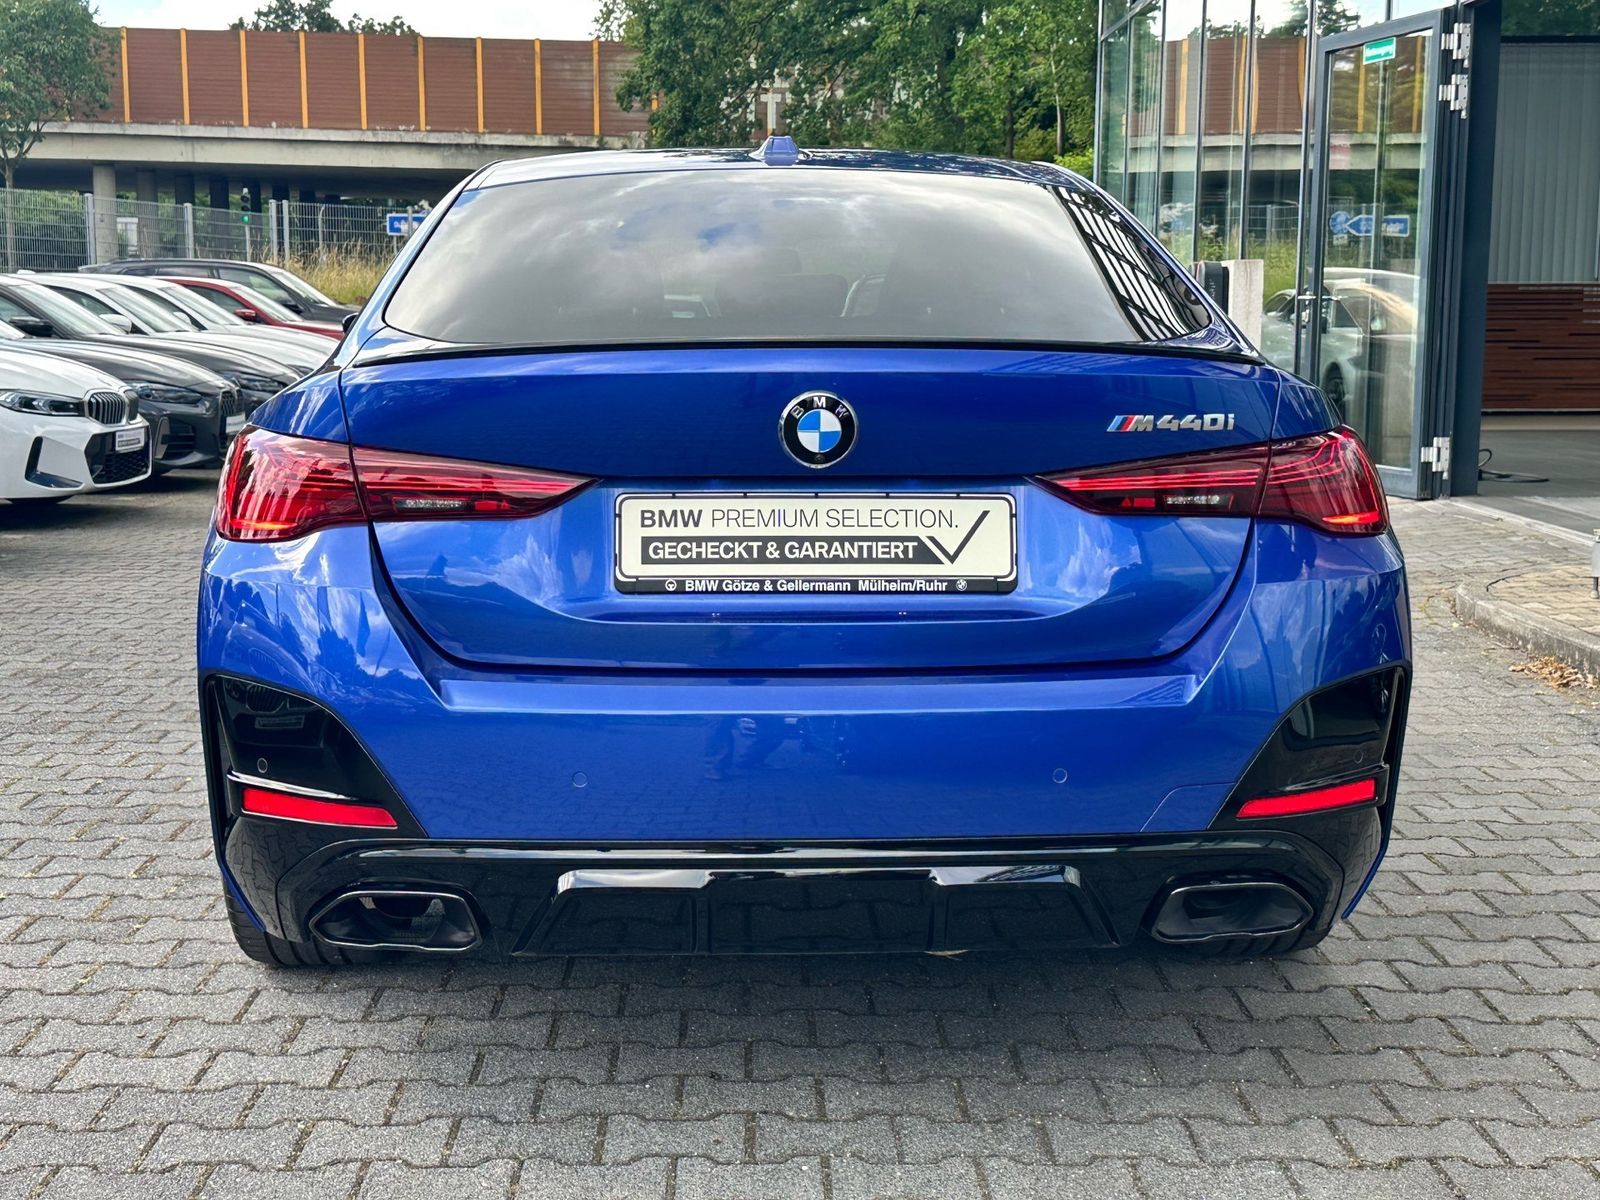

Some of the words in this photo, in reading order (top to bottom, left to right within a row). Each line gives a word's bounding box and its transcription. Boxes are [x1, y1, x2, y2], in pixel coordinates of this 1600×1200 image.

[790, 396, 849, 420] BMW
[640, 509, 703, 528] BMW
[711, 508, 818, 528] PREMIUM
[826, 508, 958, 529] SELECTION.
[648, 541, 762, 560] GECHECKT
[765, 541, 780, 559] &
[784, 541, 918, 559] GARANTIERT
[685, 579, 719, 592] BMW
[722, 579, 760, 592] Götze
[763, 579, 774, 592] &
[776, 579, 851, 592] Gellermann
[858, 579, 948, 592] Mülheim/Ruhr
